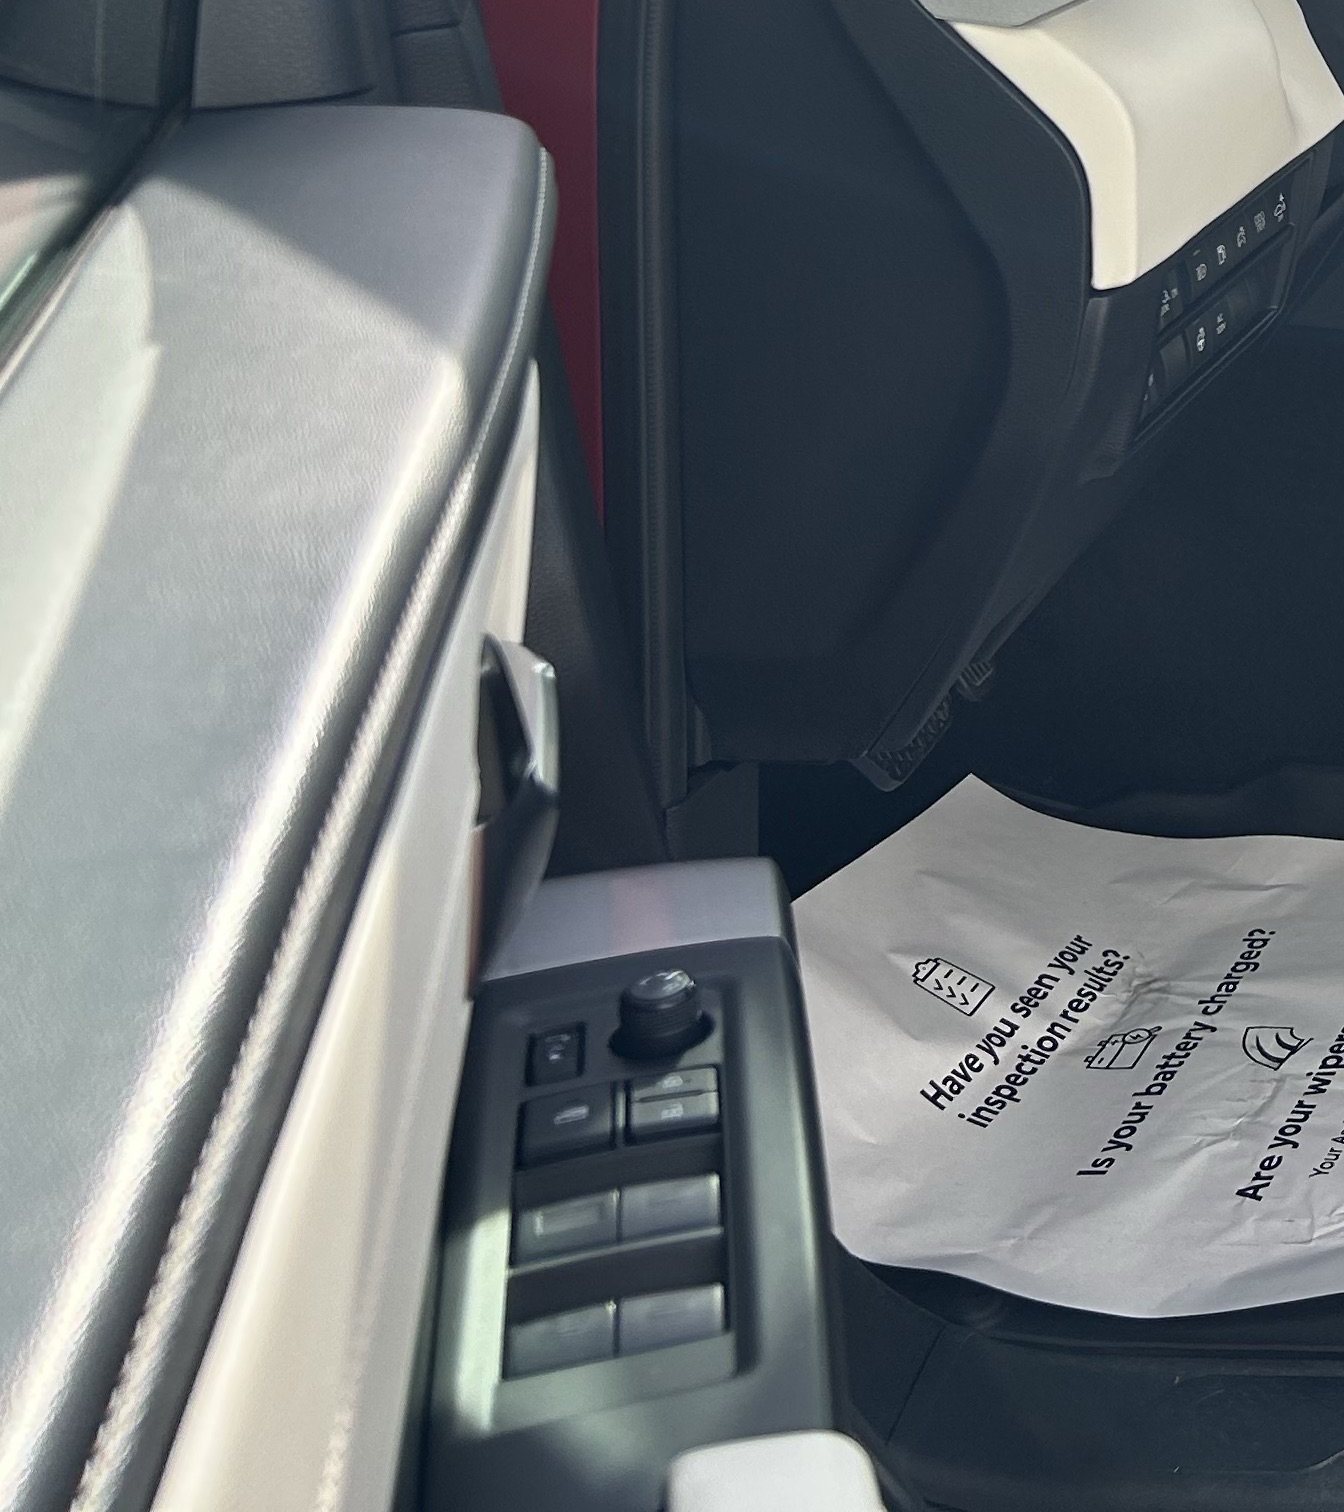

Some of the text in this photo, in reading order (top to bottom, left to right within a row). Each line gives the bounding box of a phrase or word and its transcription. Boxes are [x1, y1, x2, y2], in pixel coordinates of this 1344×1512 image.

[920, 935, 1092, 1110] Have you seen your
[958, 950, 1130, 1128] inspection results?
[1077, 929, 1275, 1175] Is your battery charged?
[1236, 1147, 1282, 1201] Are
[1268, 1100, 1316, 1148] your
[1309, 1147, 1342, 1177] Your
